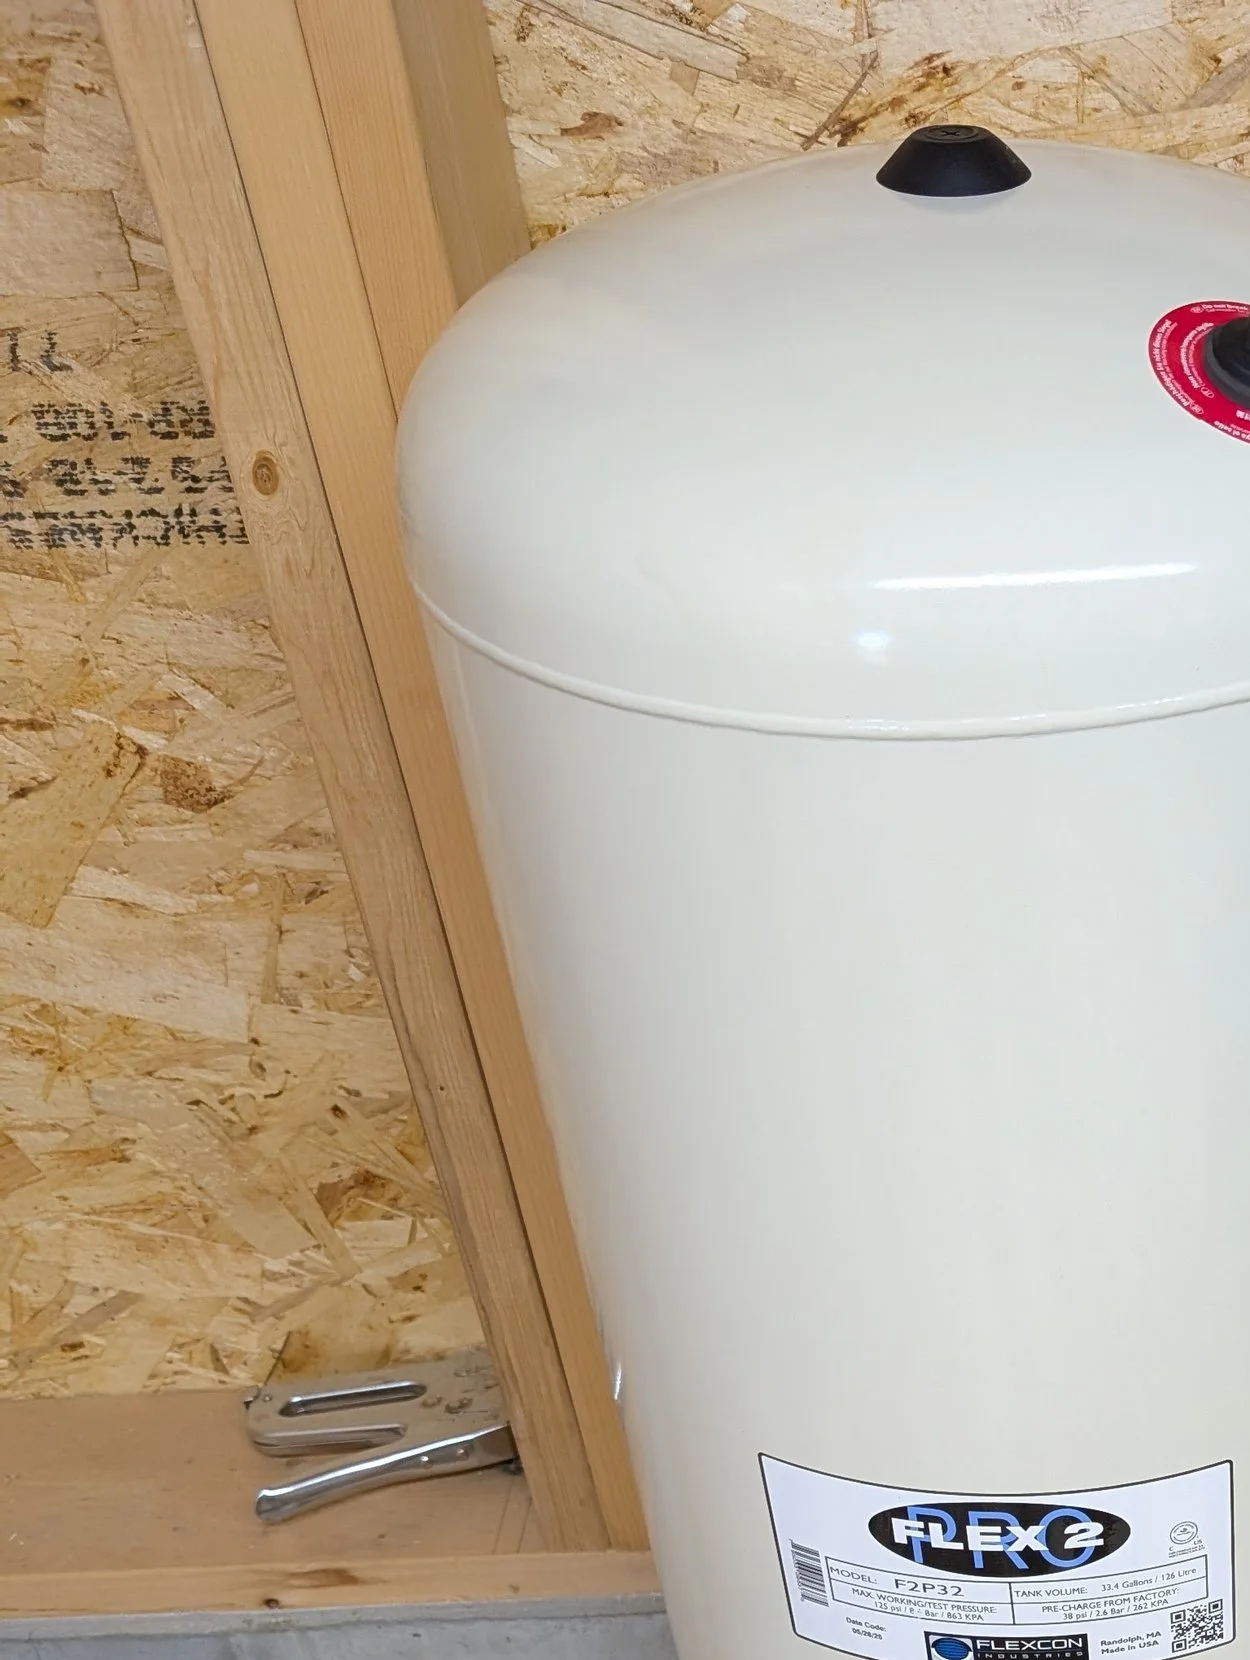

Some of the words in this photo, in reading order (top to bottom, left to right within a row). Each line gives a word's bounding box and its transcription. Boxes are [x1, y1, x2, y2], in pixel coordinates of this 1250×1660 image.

[891, 1517, 1049, 1551] FLEX
[1063, 1522, 1105, 1550] 2
[906, 1505, 1097, 1570] PRO
[830, 1566, 878, 1584] MODEL:
[894, 1578, 965, 1597] F2P32
[1101, 1583, 1119, 1592] 33.4
[1122, 1578, 1153, 1589] Gallons
[1161, 1572, 1176, 1582] 126
[1178, 1567, 1197, 1577] Litre
[852, 1588, 874, 1600] MAX.
[876, 1593, 950, 1611] WORKING/TEST
[1014, 1590, 1043, 1598] TANK
[1045, 1587, 1088, 1597] VOLUME:
[1041, 1601, 1101, 1613] PRE-CHARGE
[1104, 1597, 1131, 1608] FROM
[1133, 1587, 1180, 1604] FACTORY:
[874, 1601, 888, 1610] 125
[890, 1605, 902, 1613] psi
[925, 1609, 939, 1618] Bar
[946, 1612, 963, 1620] 863
[965, 1613, 985, 1622] KPA
[1063, 1612, 1073, 1620] 38
[1075, 1611, 1087, 1620] psi
[1095, 1608, 1109, 1617] 2.6
[1110, 1606, 1124, 1615] Bar
[1133, 1602, 1149, 1612] 262
[1150, 1598, 1169, 1609] KPA
[846, 1616, 863, 1627] Date
[864, 1621, 887, 1632] Code:
[976, 1637, 1083, 1651] FLEXCON
[1100, 1635, 1145, 1648] Randolph,
[1146, 1630, 1162, 1640] MA
[1101, 1645, 1126, 1655] Made
[1127, 1643, 1136, 1651] in
[1138, 1639, 1160, 1650] USA
[978, 1651, 1083, 1660] INDUSTRIES
